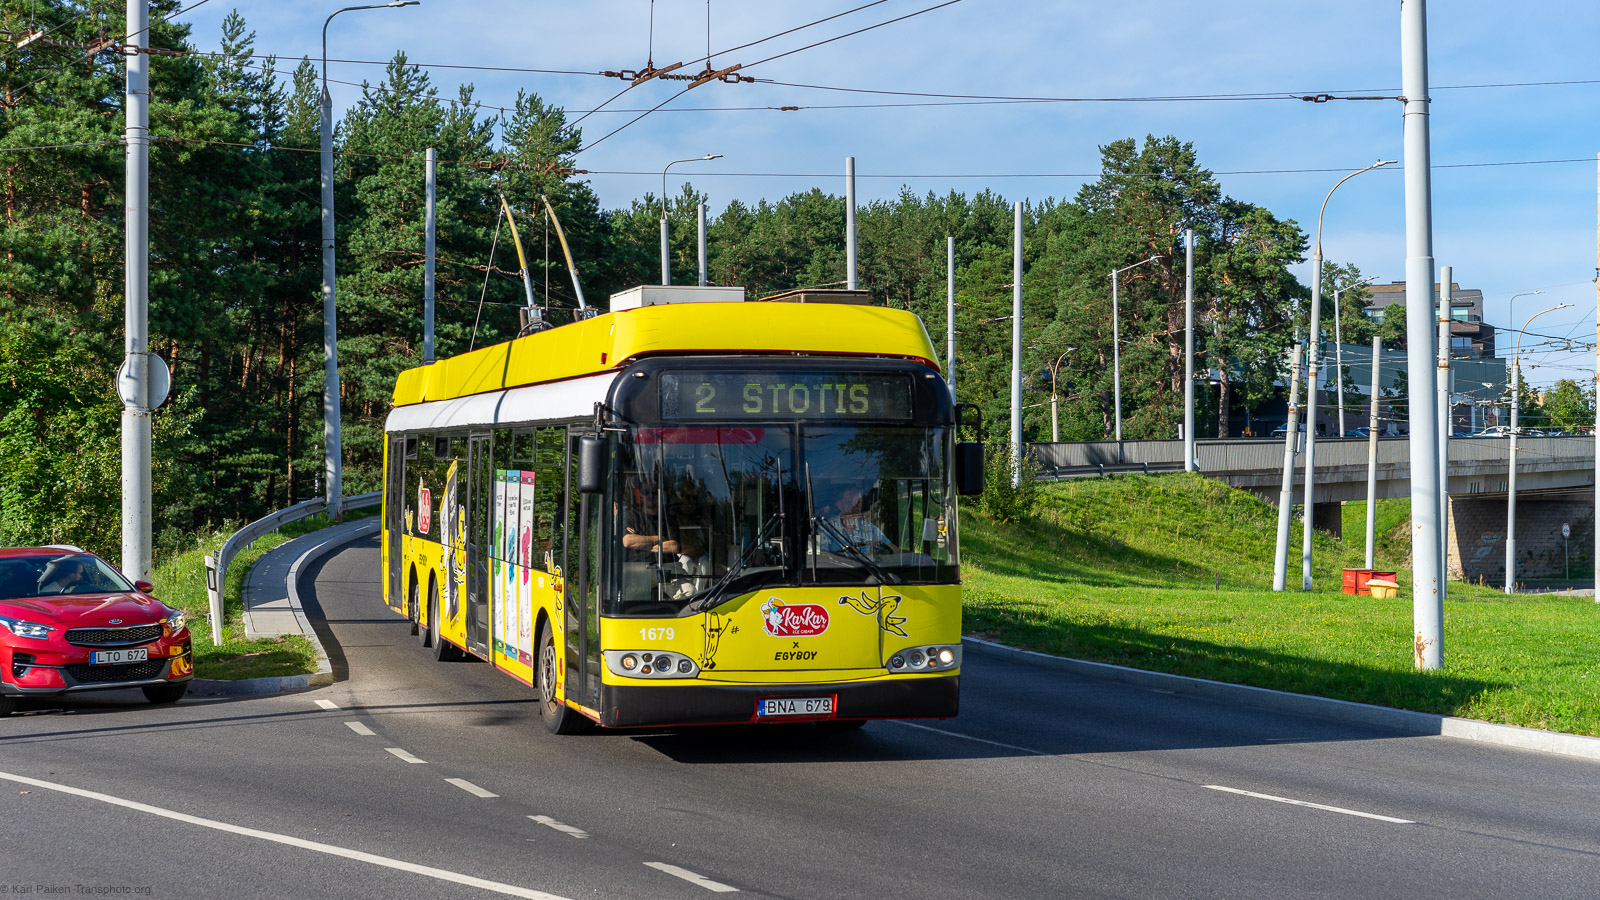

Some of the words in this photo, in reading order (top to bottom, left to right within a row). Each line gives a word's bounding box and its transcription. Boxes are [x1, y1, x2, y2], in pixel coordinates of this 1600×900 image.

[695, 383, 716, 412] 2
[742, 383, 869, 413] STOTIS
[782, 607, 827, 629] KarKar
[640, 627, 675, 641] 1679
[97, 651, 121, 663] LTO
[127, 649, 146, 661] 672
[774, 651, 818, 660] EGYBOY
[767, 700, 796, 713] BNA
[805, 699, 831, 712] 679
